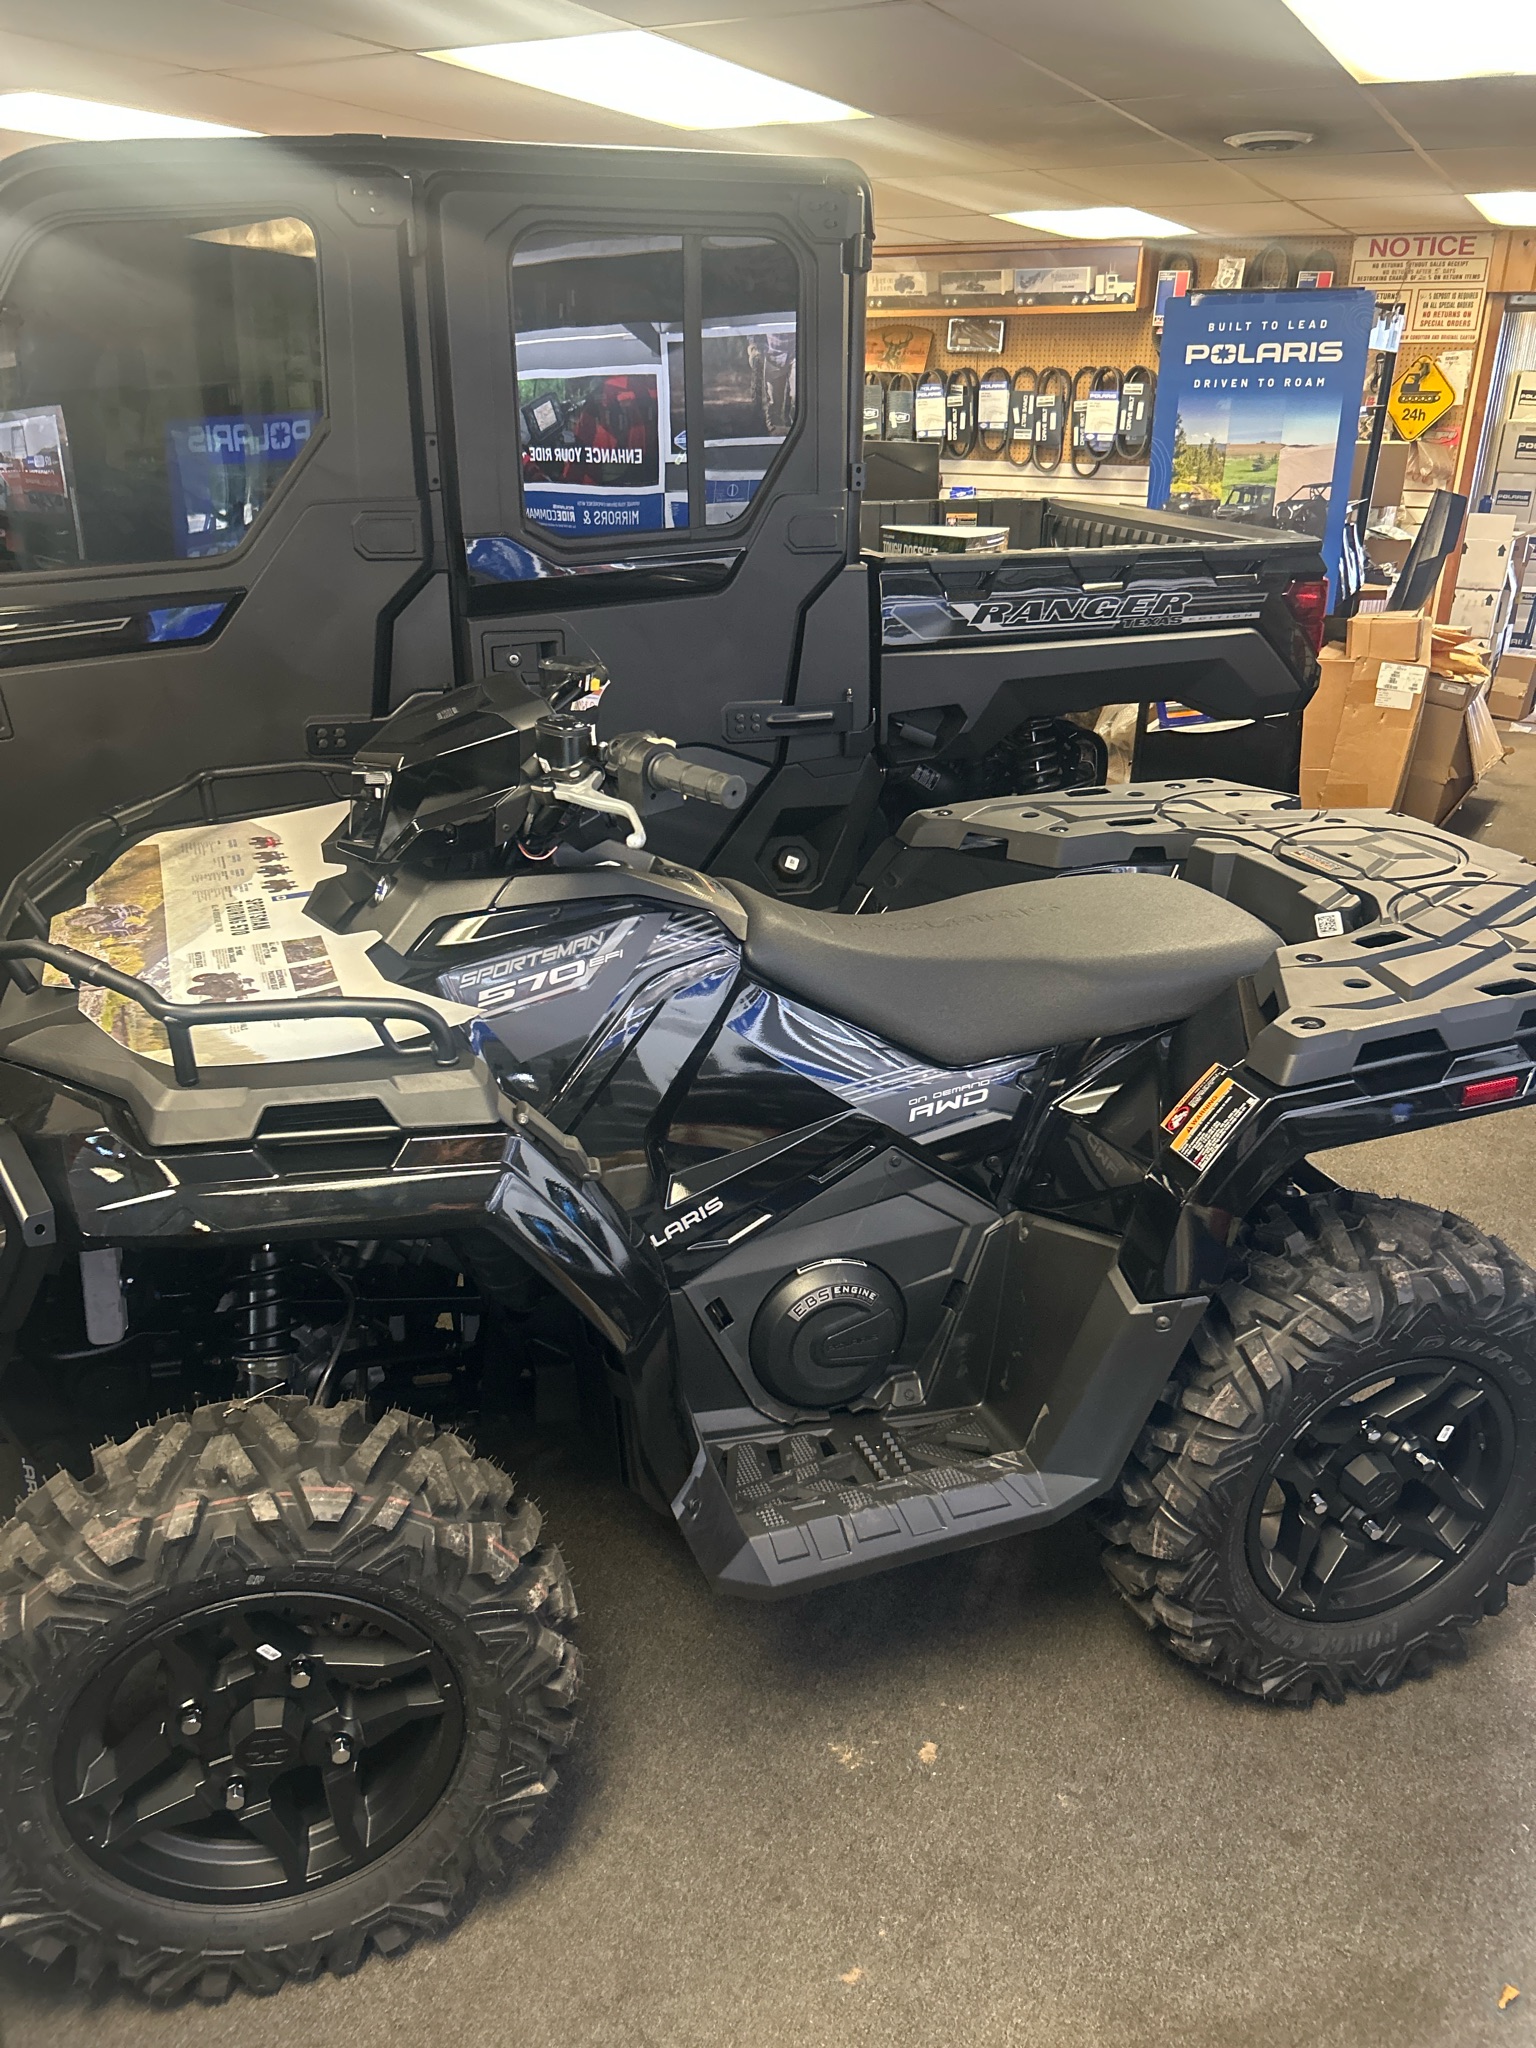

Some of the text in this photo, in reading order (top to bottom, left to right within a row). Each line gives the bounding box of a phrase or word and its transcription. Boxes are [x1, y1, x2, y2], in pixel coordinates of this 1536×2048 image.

[1369, 235, 1477, 257] NOTICE
[1377, 292, 1399, 300] ETURNS
[1457, 292, 1478, 300] REQUIRED
[1208, 319, 1328, 332] BUILT TO LEAD
[1185, 341, 1344, 365] POLARIS
[1193, 377, 1326, 389] DRIVEN TO ROAM
[1401, 408, 1426, 421] 24h
[968, 592, 1193, 627] RANGER
[1121, 613, 1252, 629] TEXAS EDITION
[225, 901, 247, 925] TOURING
[245, 898, 271, 931] SPORTSMAN
[230, 924, 250, 936] 570
[459, 931, 606, 989] SPORTSMAN
[478, 949, 623, 1007] 570 EFI
[908, 1079, 990, 1106] ON DEMAND
[908, 1088, 989, 1122] AWD
[1191, 1095, 1218, 1125] WARNING
[649, 1196, 725, 1248] LARIS
[792, 1288, 830, 1318] EBS
[834, 1286, 877, 1300] ENGINE
